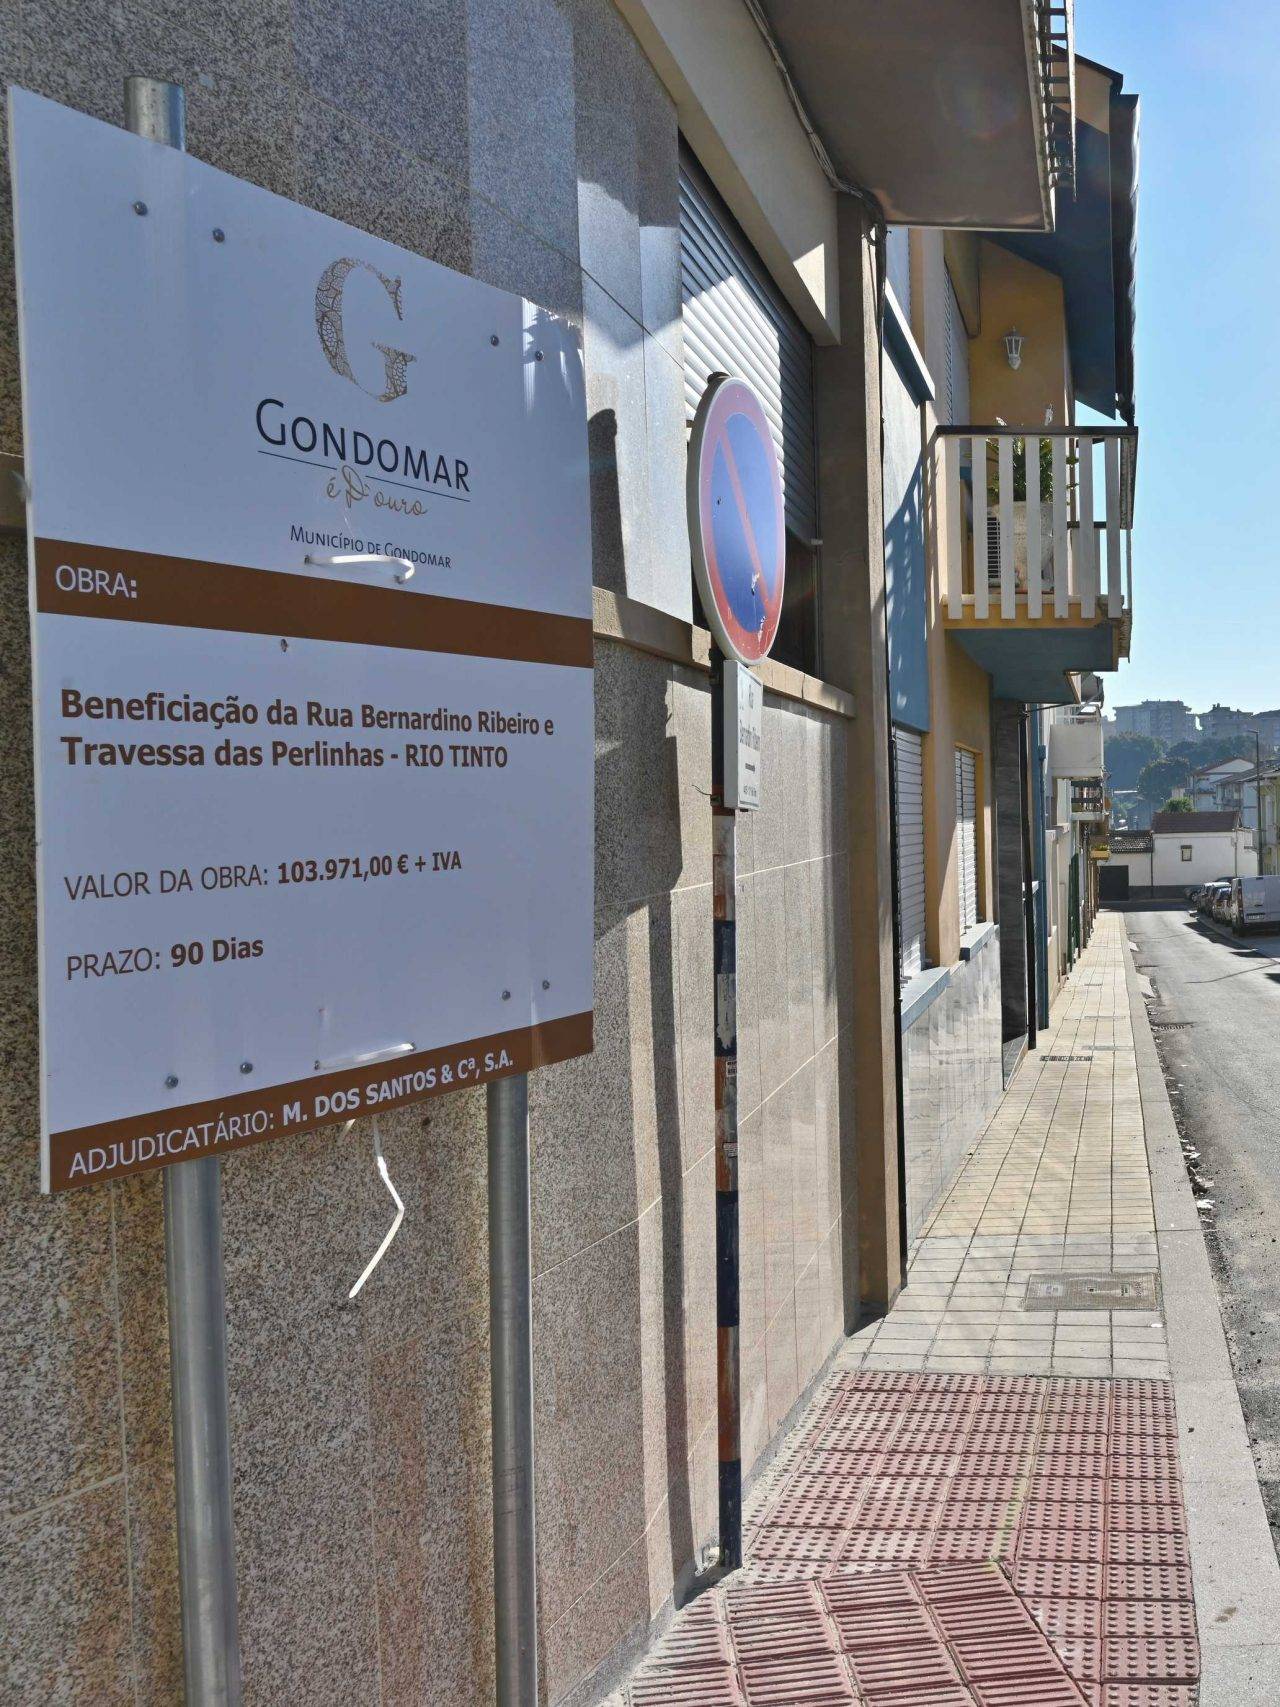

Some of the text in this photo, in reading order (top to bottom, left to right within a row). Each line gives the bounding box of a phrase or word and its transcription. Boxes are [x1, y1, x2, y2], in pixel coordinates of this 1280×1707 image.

[315, 257, 416, 402] G
[55, 564, 138, 599] OBRA:
[61, 688, 554, 736] Beneficiação da Rua Bernardino Ribeiro e
[60, 736, 205, 766] Travessa
[214, 738, 263, 767] das
[272, 740, 385, 767] Perlinhas
[405, 744, 444, 768] RIO
[449, 745, 509, 768] TINTO
[64, 850, 462, 901] VALOR DA OBRA: 103.971,00 € + IVA
[66, 936, 264, 981] PRAZO: 90 Dias
[68, 1111, 275, 1179] ADJUDICATÁRIO:
[282, 1101, 308, 1126] M.
[314, 1087, 360, 1119] DOS
[365, 1068, 437, 1105] SANTOS
[440, 1064, 453, 1084] &
[484, 1049, 514, 1073] S.A.
